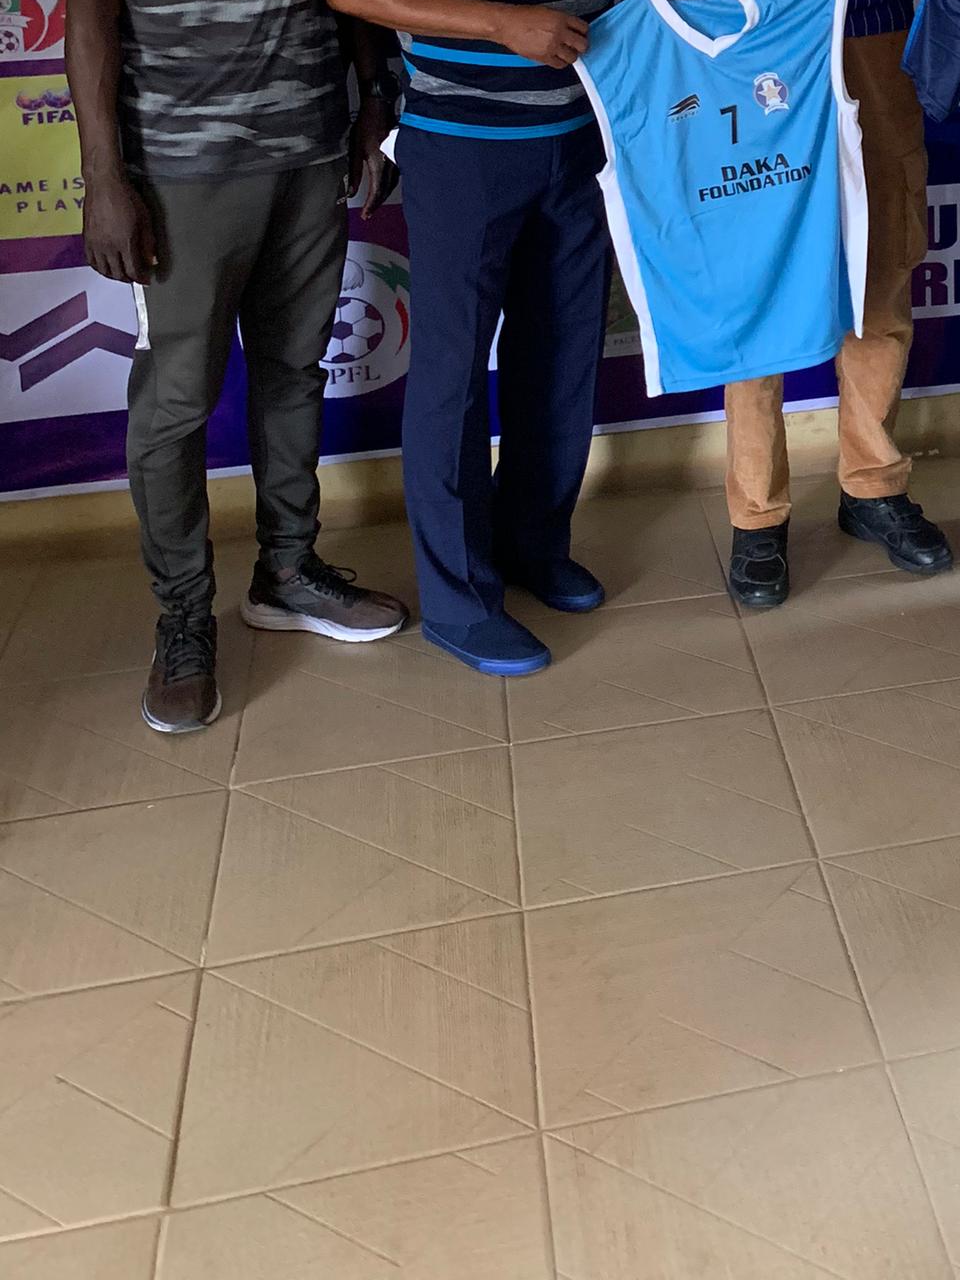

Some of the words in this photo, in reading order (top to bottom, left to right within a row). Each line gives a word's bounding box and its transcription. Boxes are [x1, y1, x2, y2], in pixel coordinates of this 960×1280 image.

[22, 110, 76, 126] FIFA
[698, 163, 813, 203] FOUNDATION
[721, 153, 790, 183] DAKA
